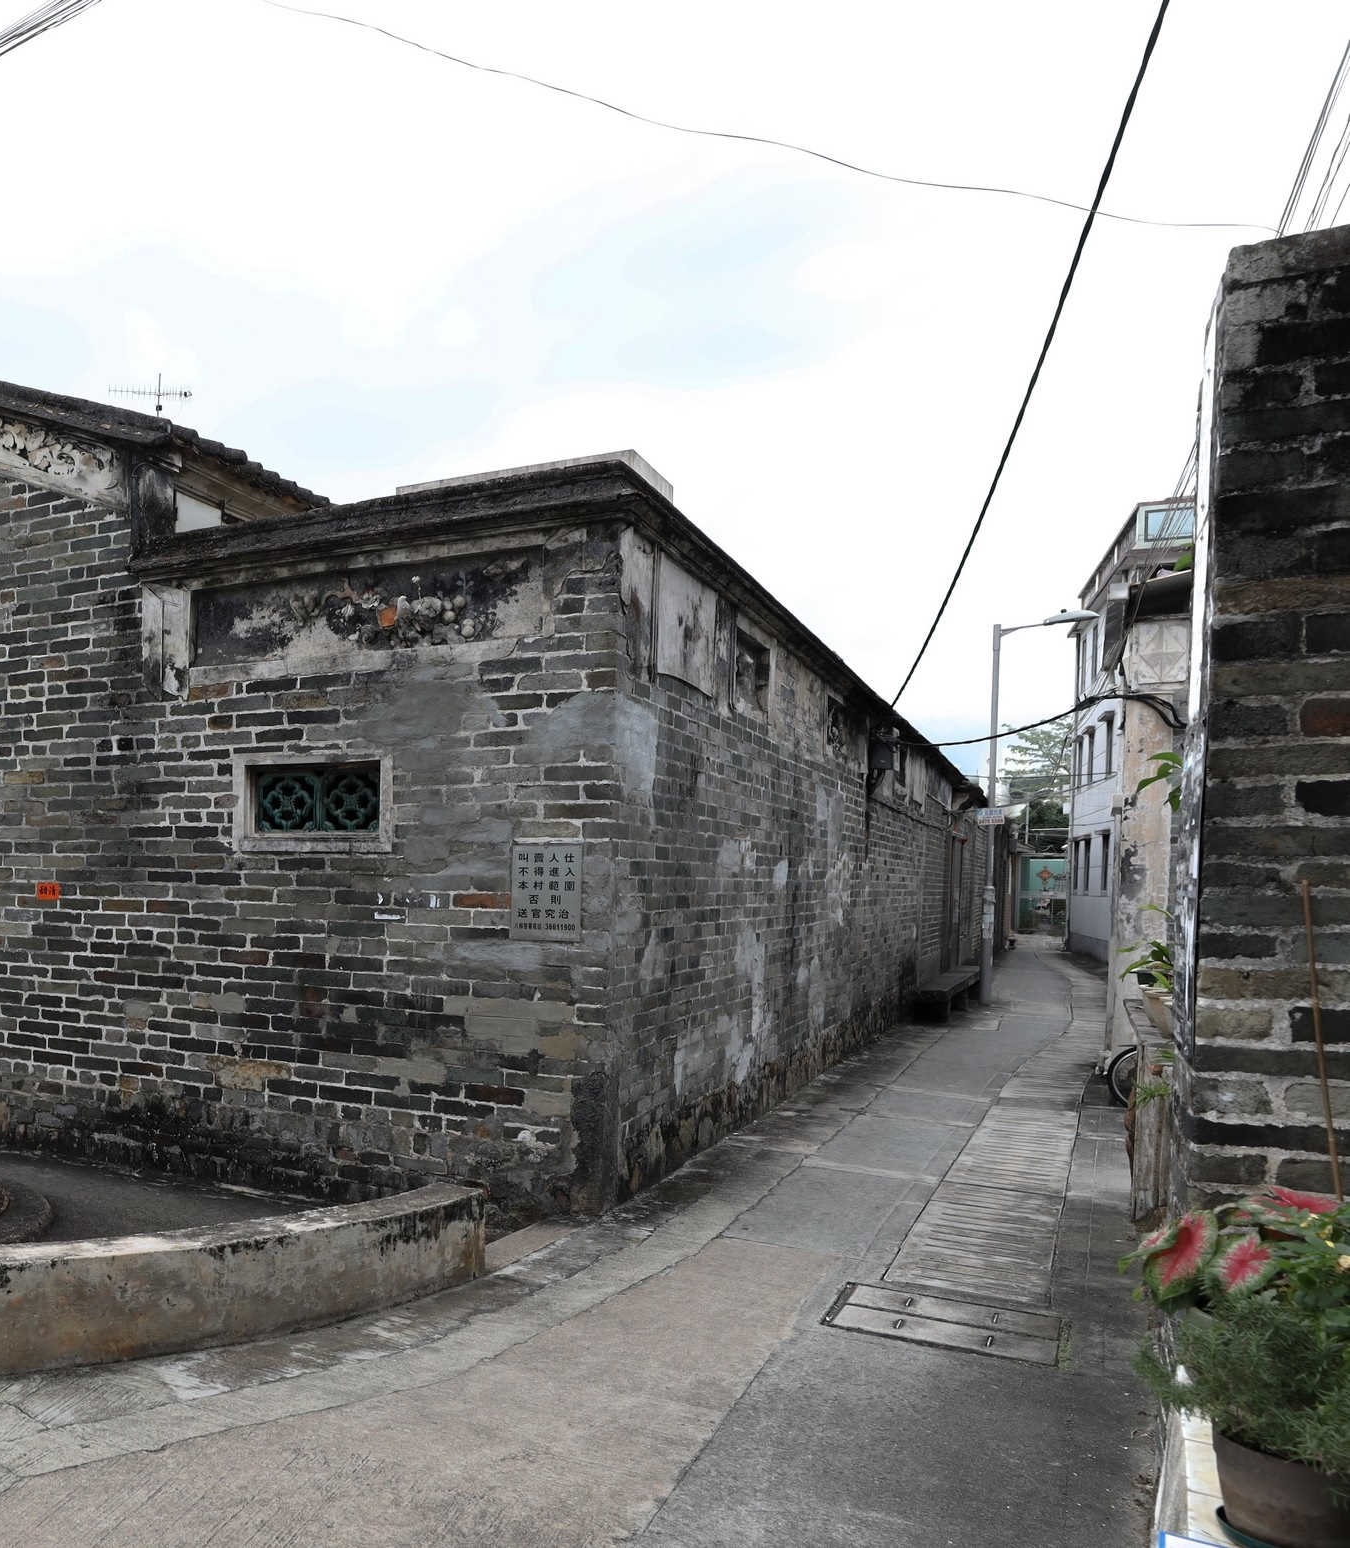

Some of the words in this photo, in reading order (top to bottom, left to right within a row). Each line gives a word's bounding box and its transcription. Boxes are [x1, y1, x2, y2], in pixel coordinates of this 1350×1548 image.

[518, 867, 575, 877] 不得進入
[518, 881, 575, 891] 本村範圍
[529, 895, 561, 905] 否則
[518, 908, 569, 919] 送官究治
